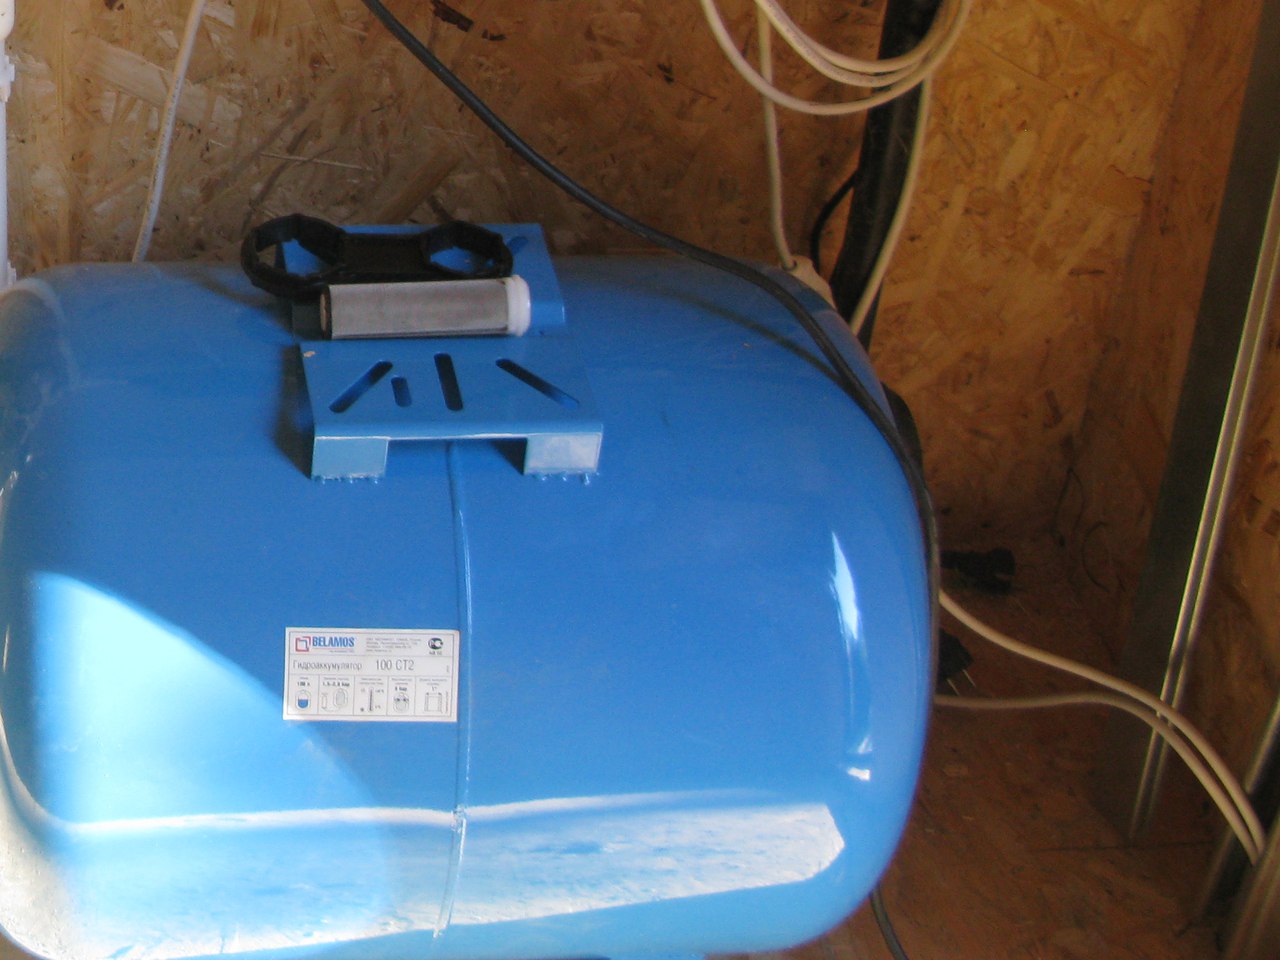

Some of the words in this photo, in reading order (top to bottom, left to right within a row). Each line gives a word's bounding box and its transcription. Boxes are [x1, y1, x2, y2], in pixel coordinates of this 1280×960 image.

[312, 636, 355, 648] BELAMOS
[293, 659, 363, 671] Гидроаккумулятор
[376, 658, 393, 671] 100
